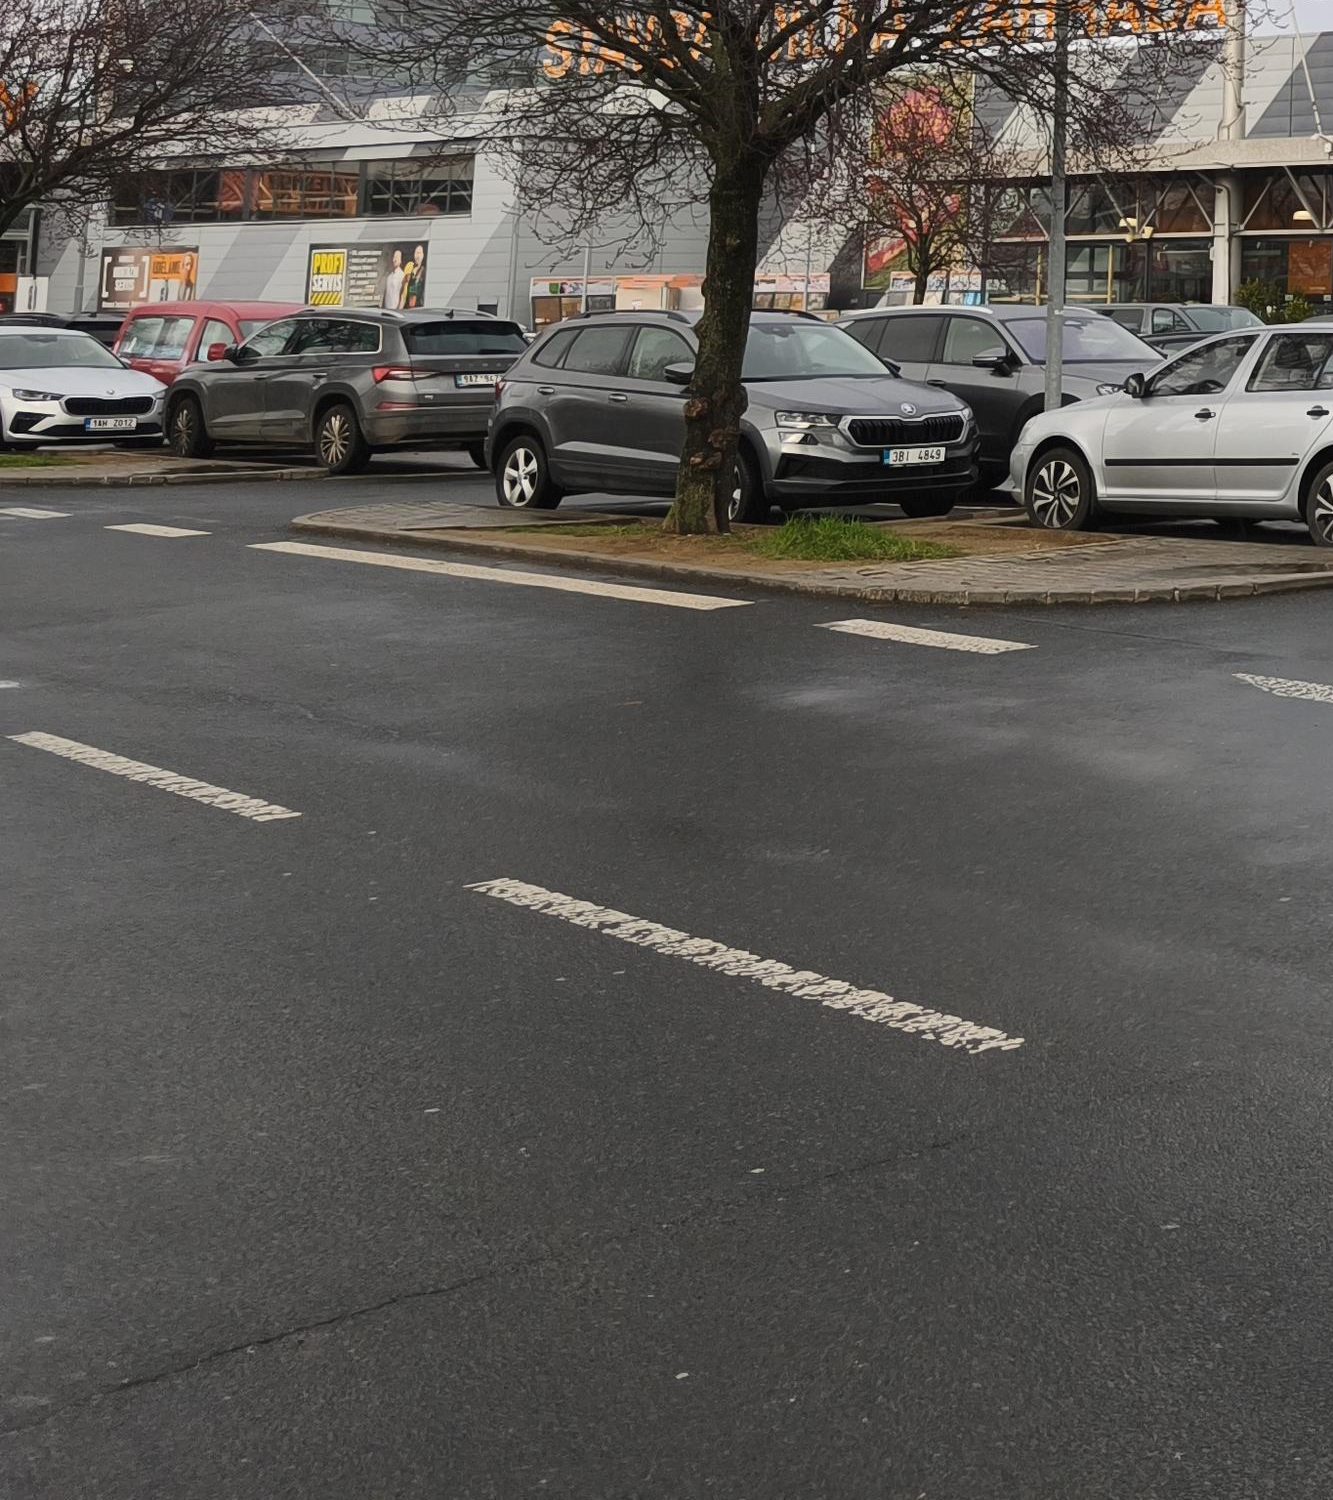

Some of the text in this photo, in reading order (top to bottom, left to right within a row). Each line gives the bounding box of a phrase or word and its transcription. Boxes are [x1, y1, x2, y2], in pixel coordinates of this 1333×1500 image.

[313, 253, 344, 274] PROFI
[312, 275, 342, 291] SERVIS
[918, 449, 940, 460] 4849
